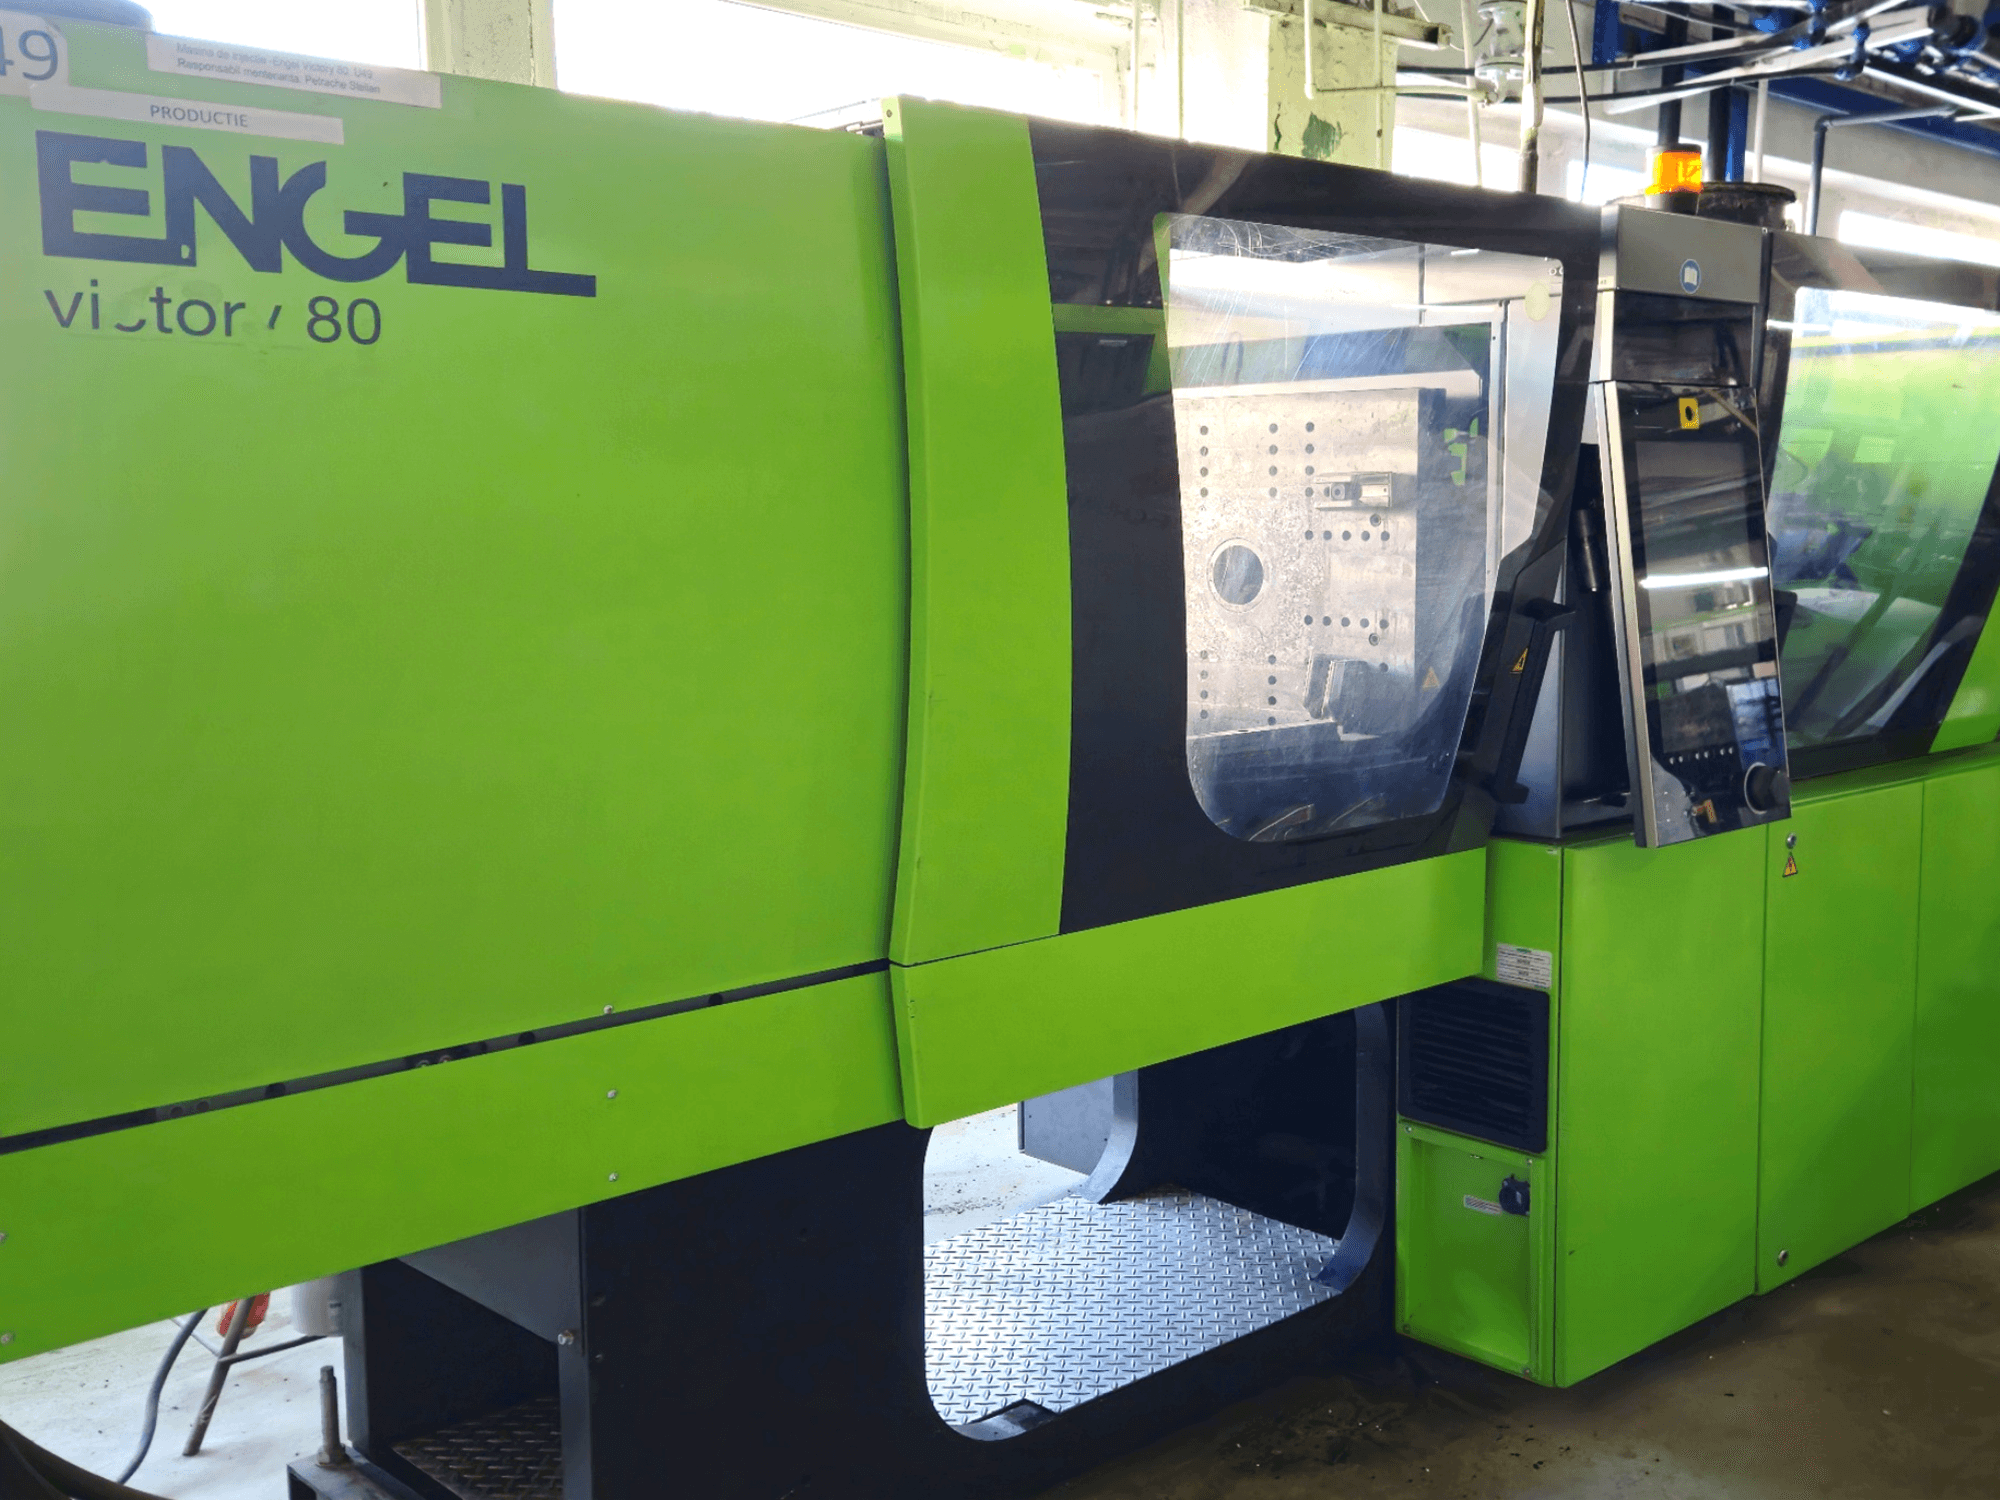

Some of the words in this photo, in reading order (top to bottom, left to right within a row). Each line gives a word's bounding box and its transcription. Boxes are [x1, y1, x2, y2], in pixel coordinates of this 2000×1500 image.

[150, 103, 249, 128] PRODUCTIE
[35, 129, 597, 298] ENGEL
[306, 295, 382, 346] 80
